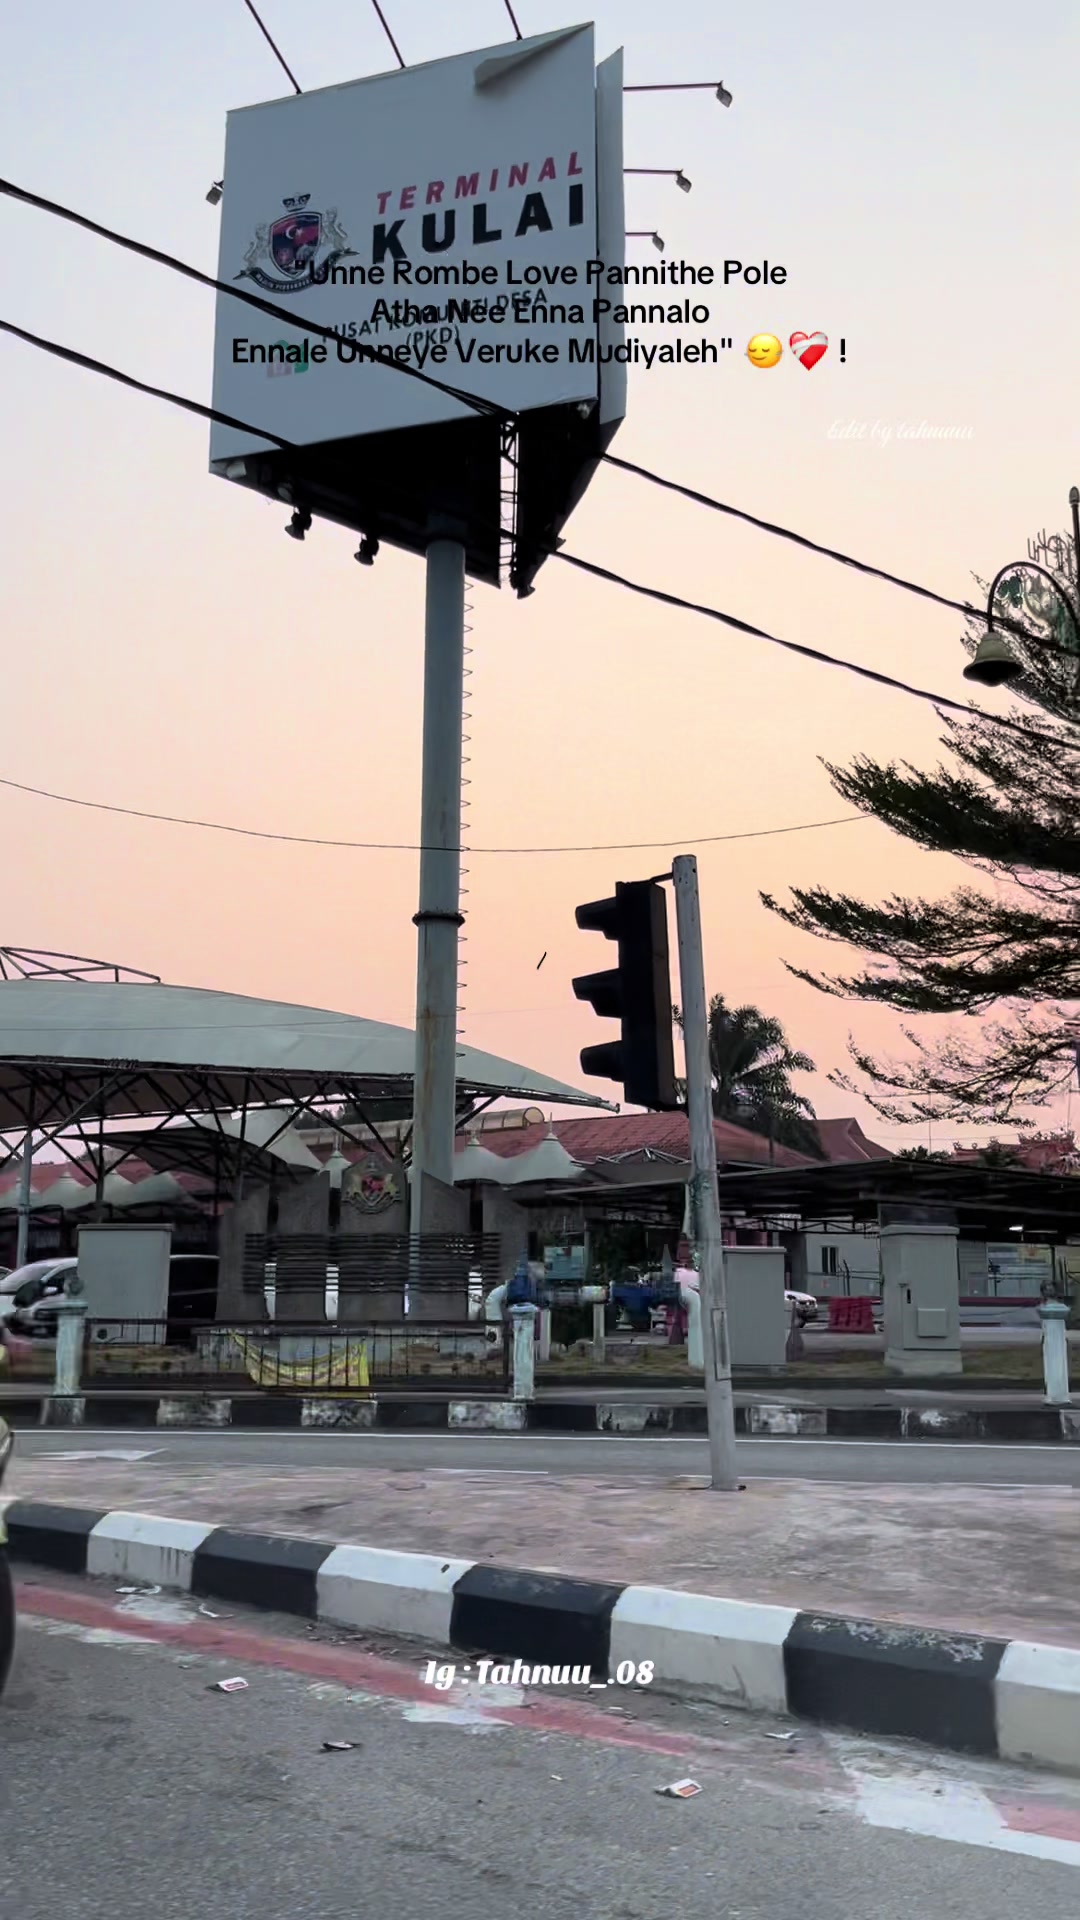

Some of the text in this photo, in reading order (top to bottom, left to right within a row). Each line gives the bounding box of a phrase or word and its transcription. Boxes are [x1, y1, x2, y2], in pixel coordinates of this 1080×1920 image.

[376, 151, 583, 215] TERMINAL
[372, 183, 584, 265] KULAI
[322, 318, 382, 344] USAT
